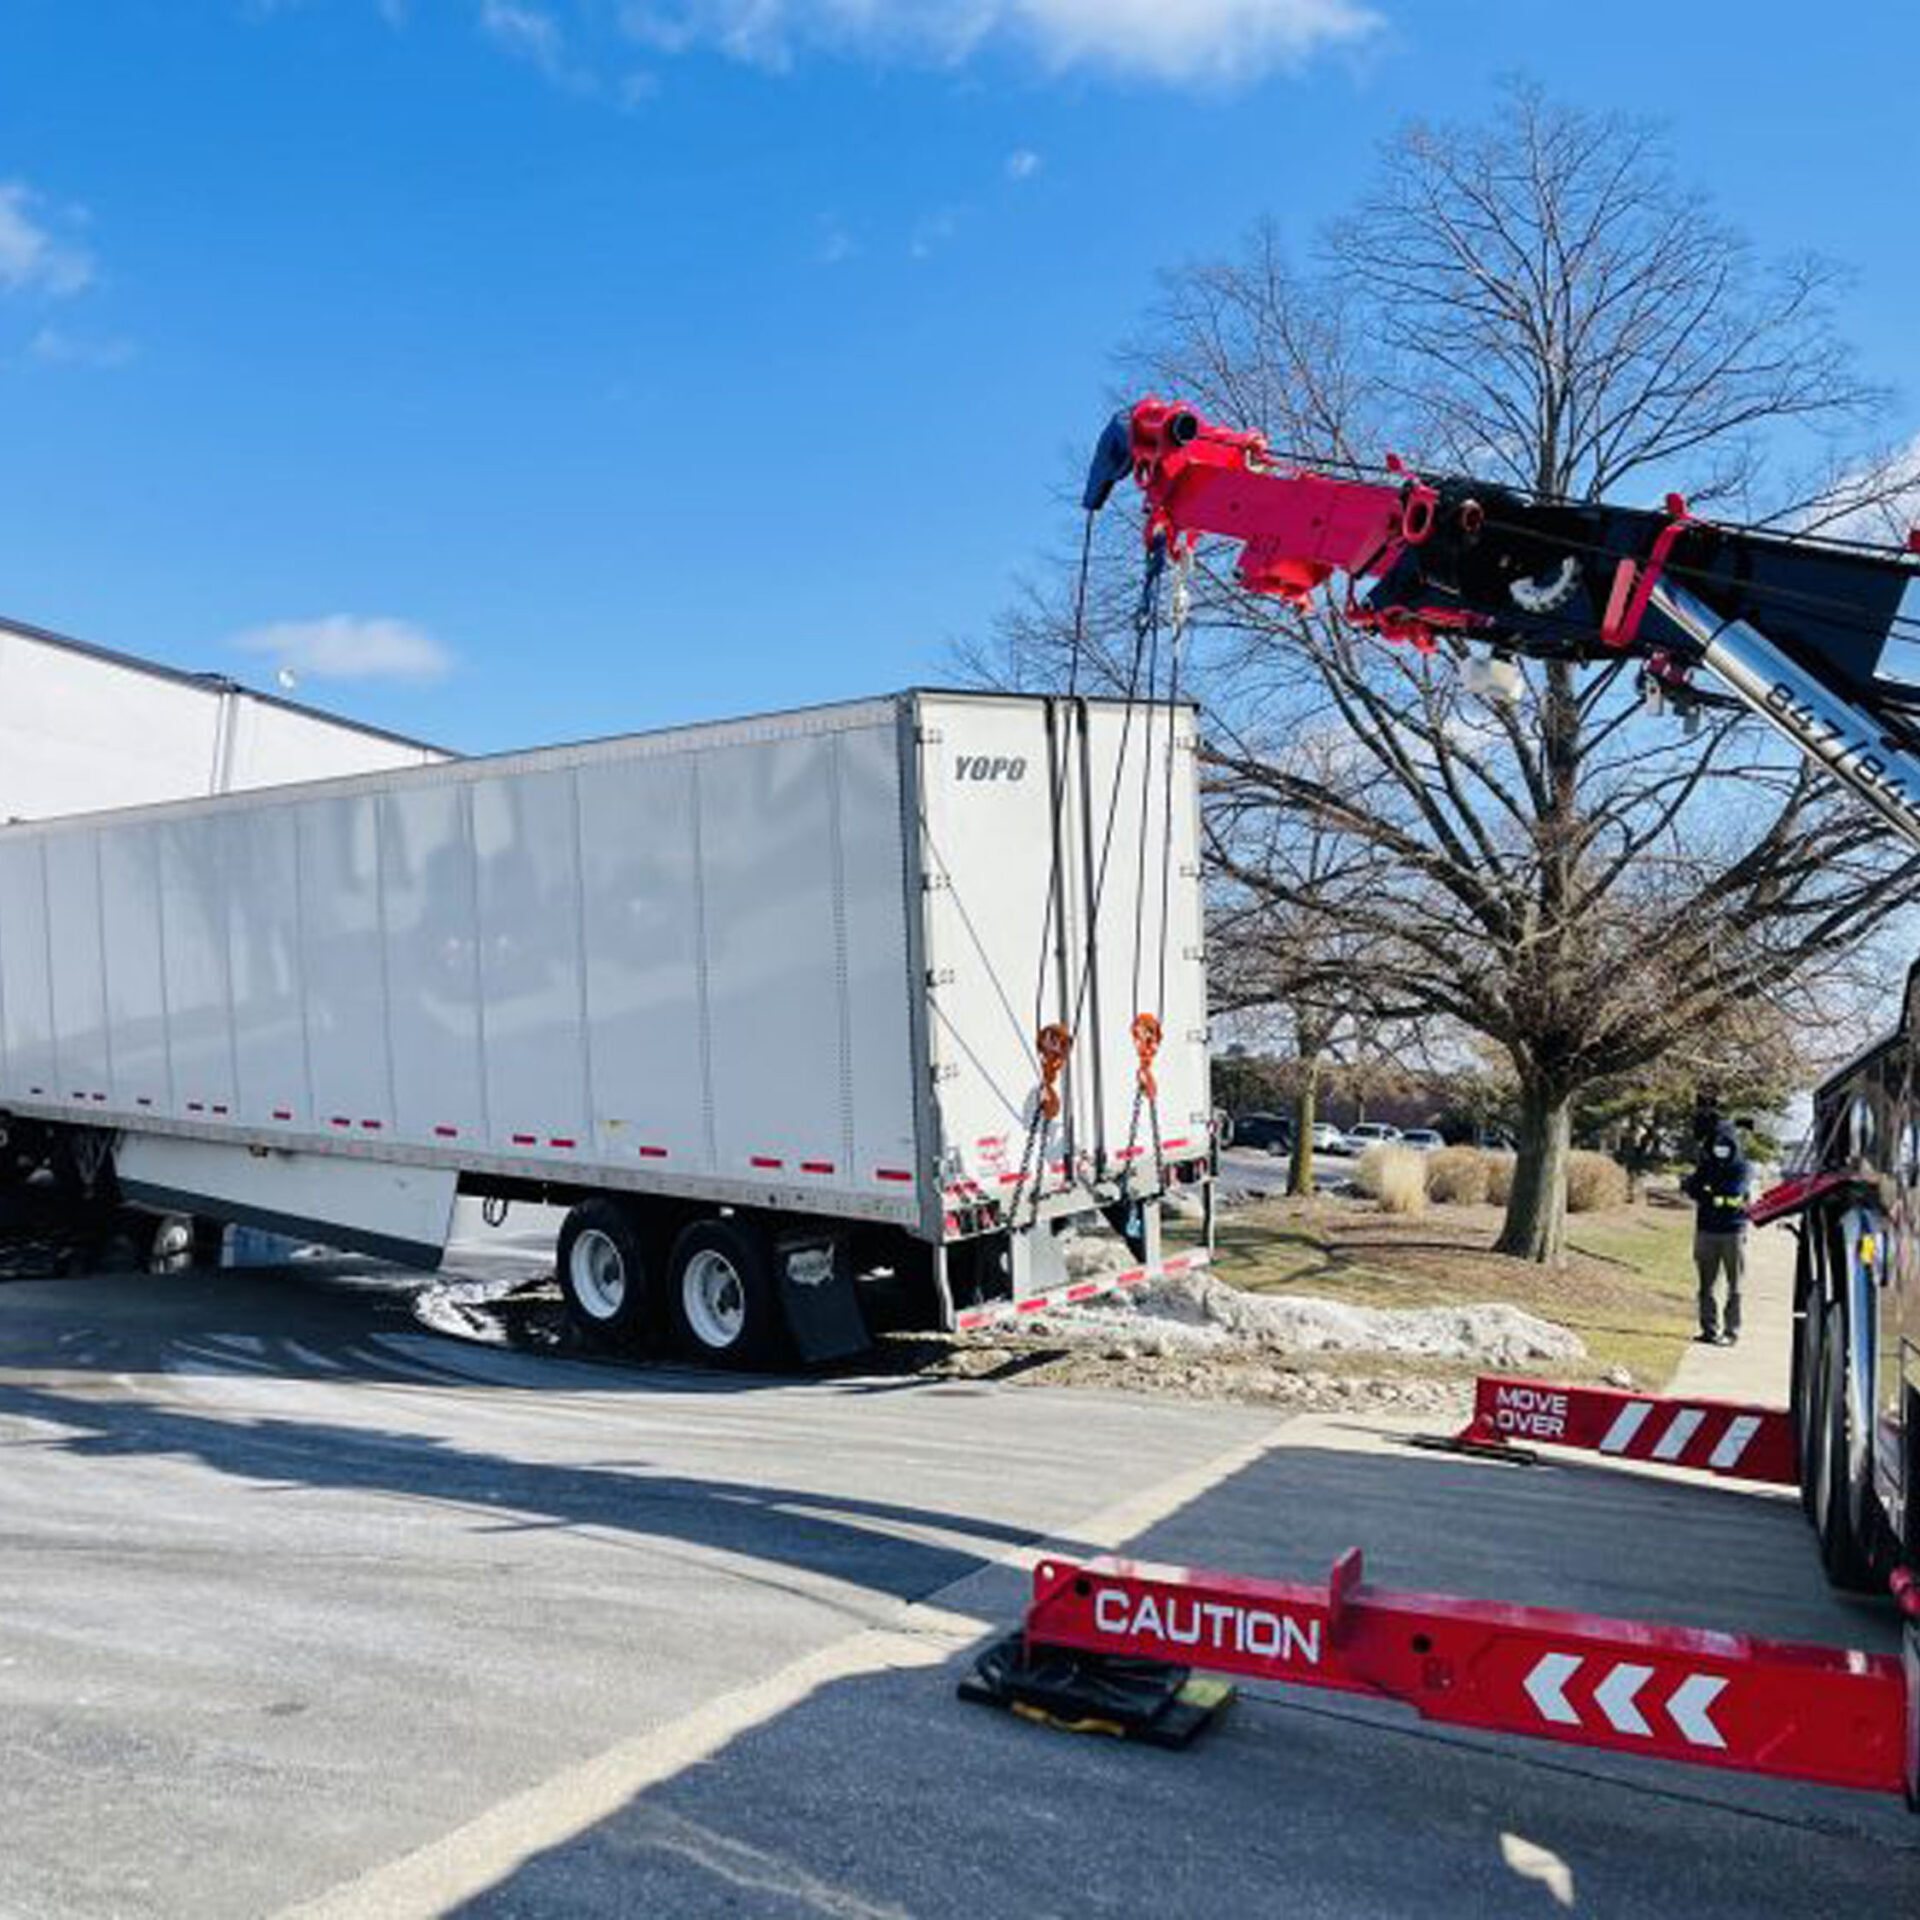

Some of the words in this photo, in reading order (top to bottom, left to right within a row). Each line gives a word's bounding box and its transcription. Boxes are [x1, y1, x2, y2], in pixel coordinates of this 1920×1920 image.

[954, 755, 1027, 781] YOPO
[1495, 1386, 1569, 1415] MOVE
[1496, 1411, 1566, 1436] OVER
[1094, 1588, 1321, 1664] CAUTION
